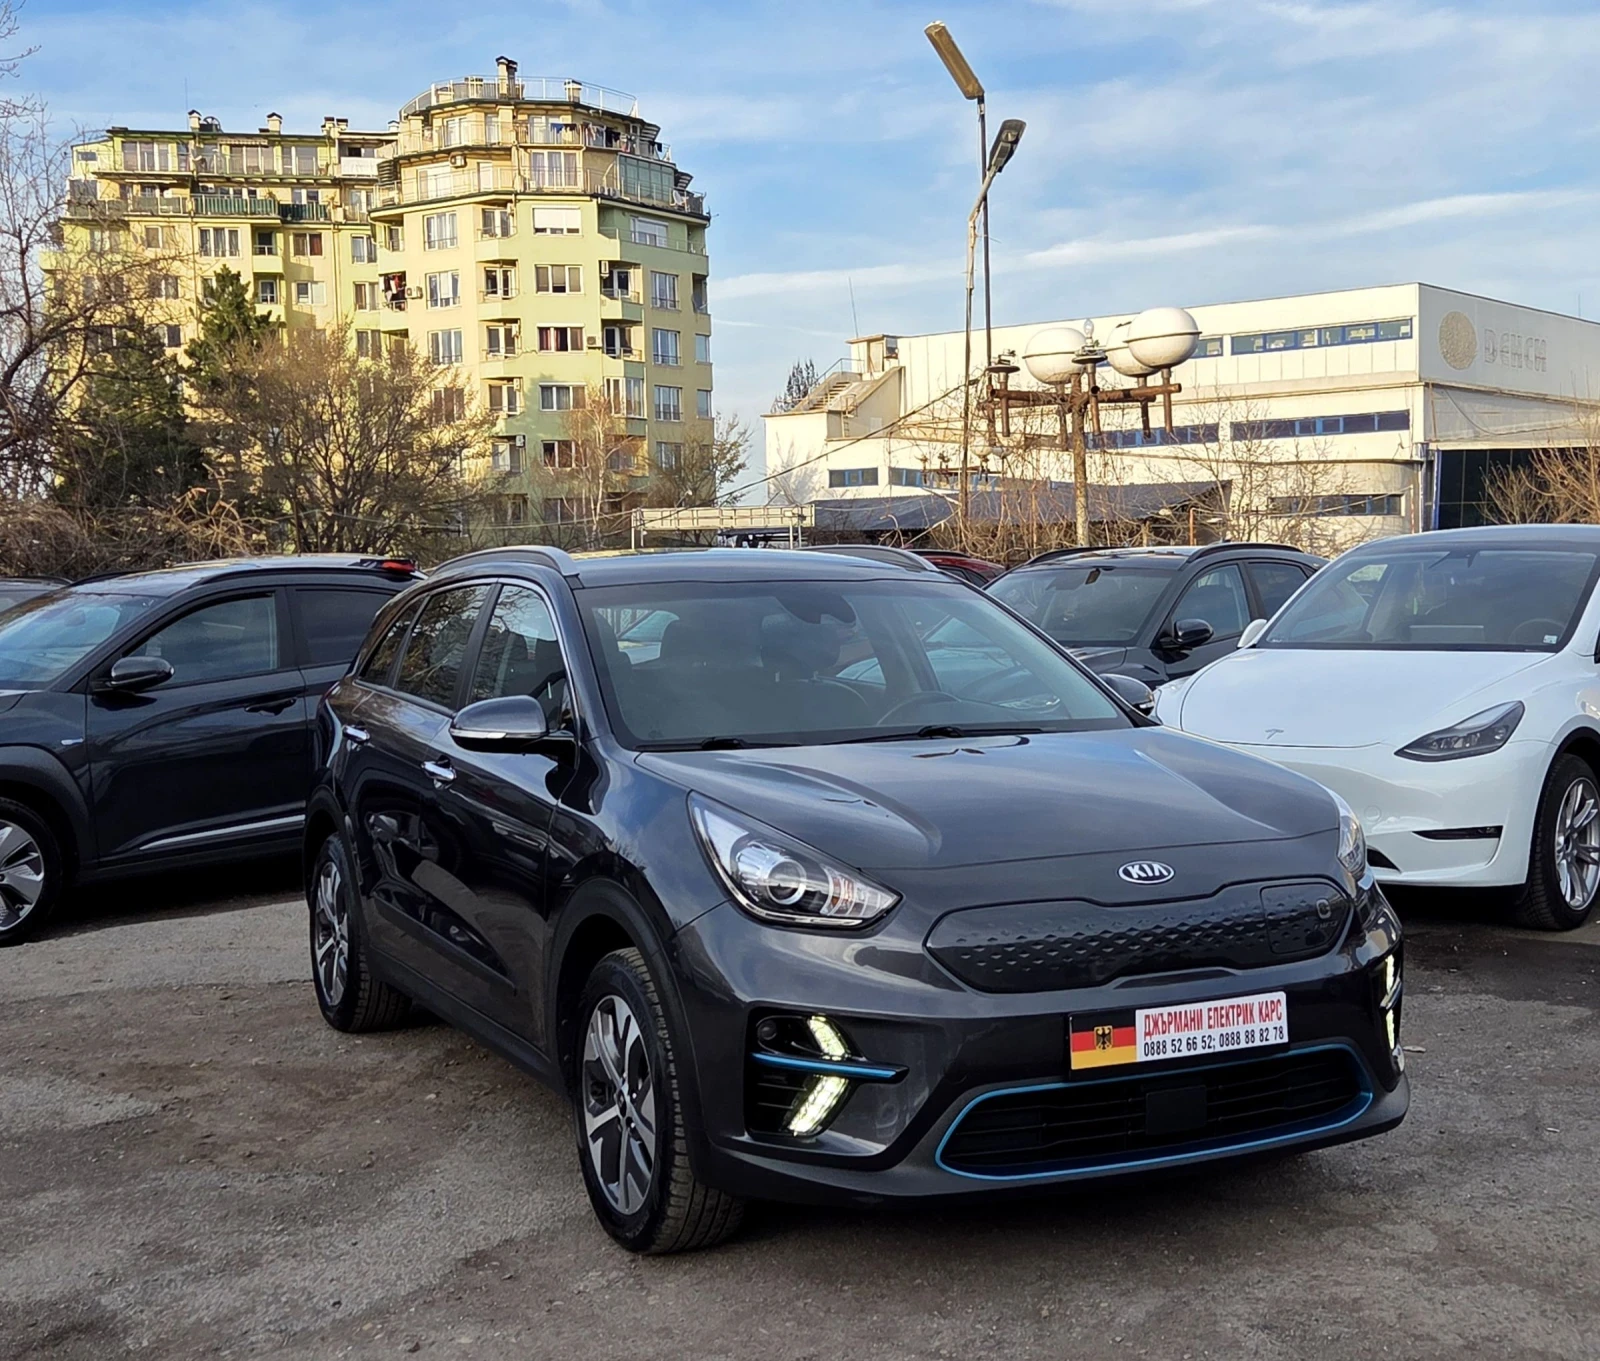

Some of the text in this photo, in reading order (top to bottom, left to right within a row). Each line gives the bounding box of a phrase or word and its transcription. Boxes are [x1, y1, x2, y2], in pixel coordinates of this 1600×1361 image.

[1125, 863, 1169, 879] KIA
[1143, 998, 1283, 1041] ДЖЪРМАНИ ЕЛЕКТРИК КАРС
[1143, 1040, 1168, 1057] 0888
[1171, 1038, 1183, 1054] 52
[1186, 1036, 1198, 1052] 66
[1219, 1031, 1241, 1048] 0888
[1244, 1029, 1256, 1045] 88
[1259, 1027, 1270, 1043] 82
[1273, 1025, 1285, 1041] 78
